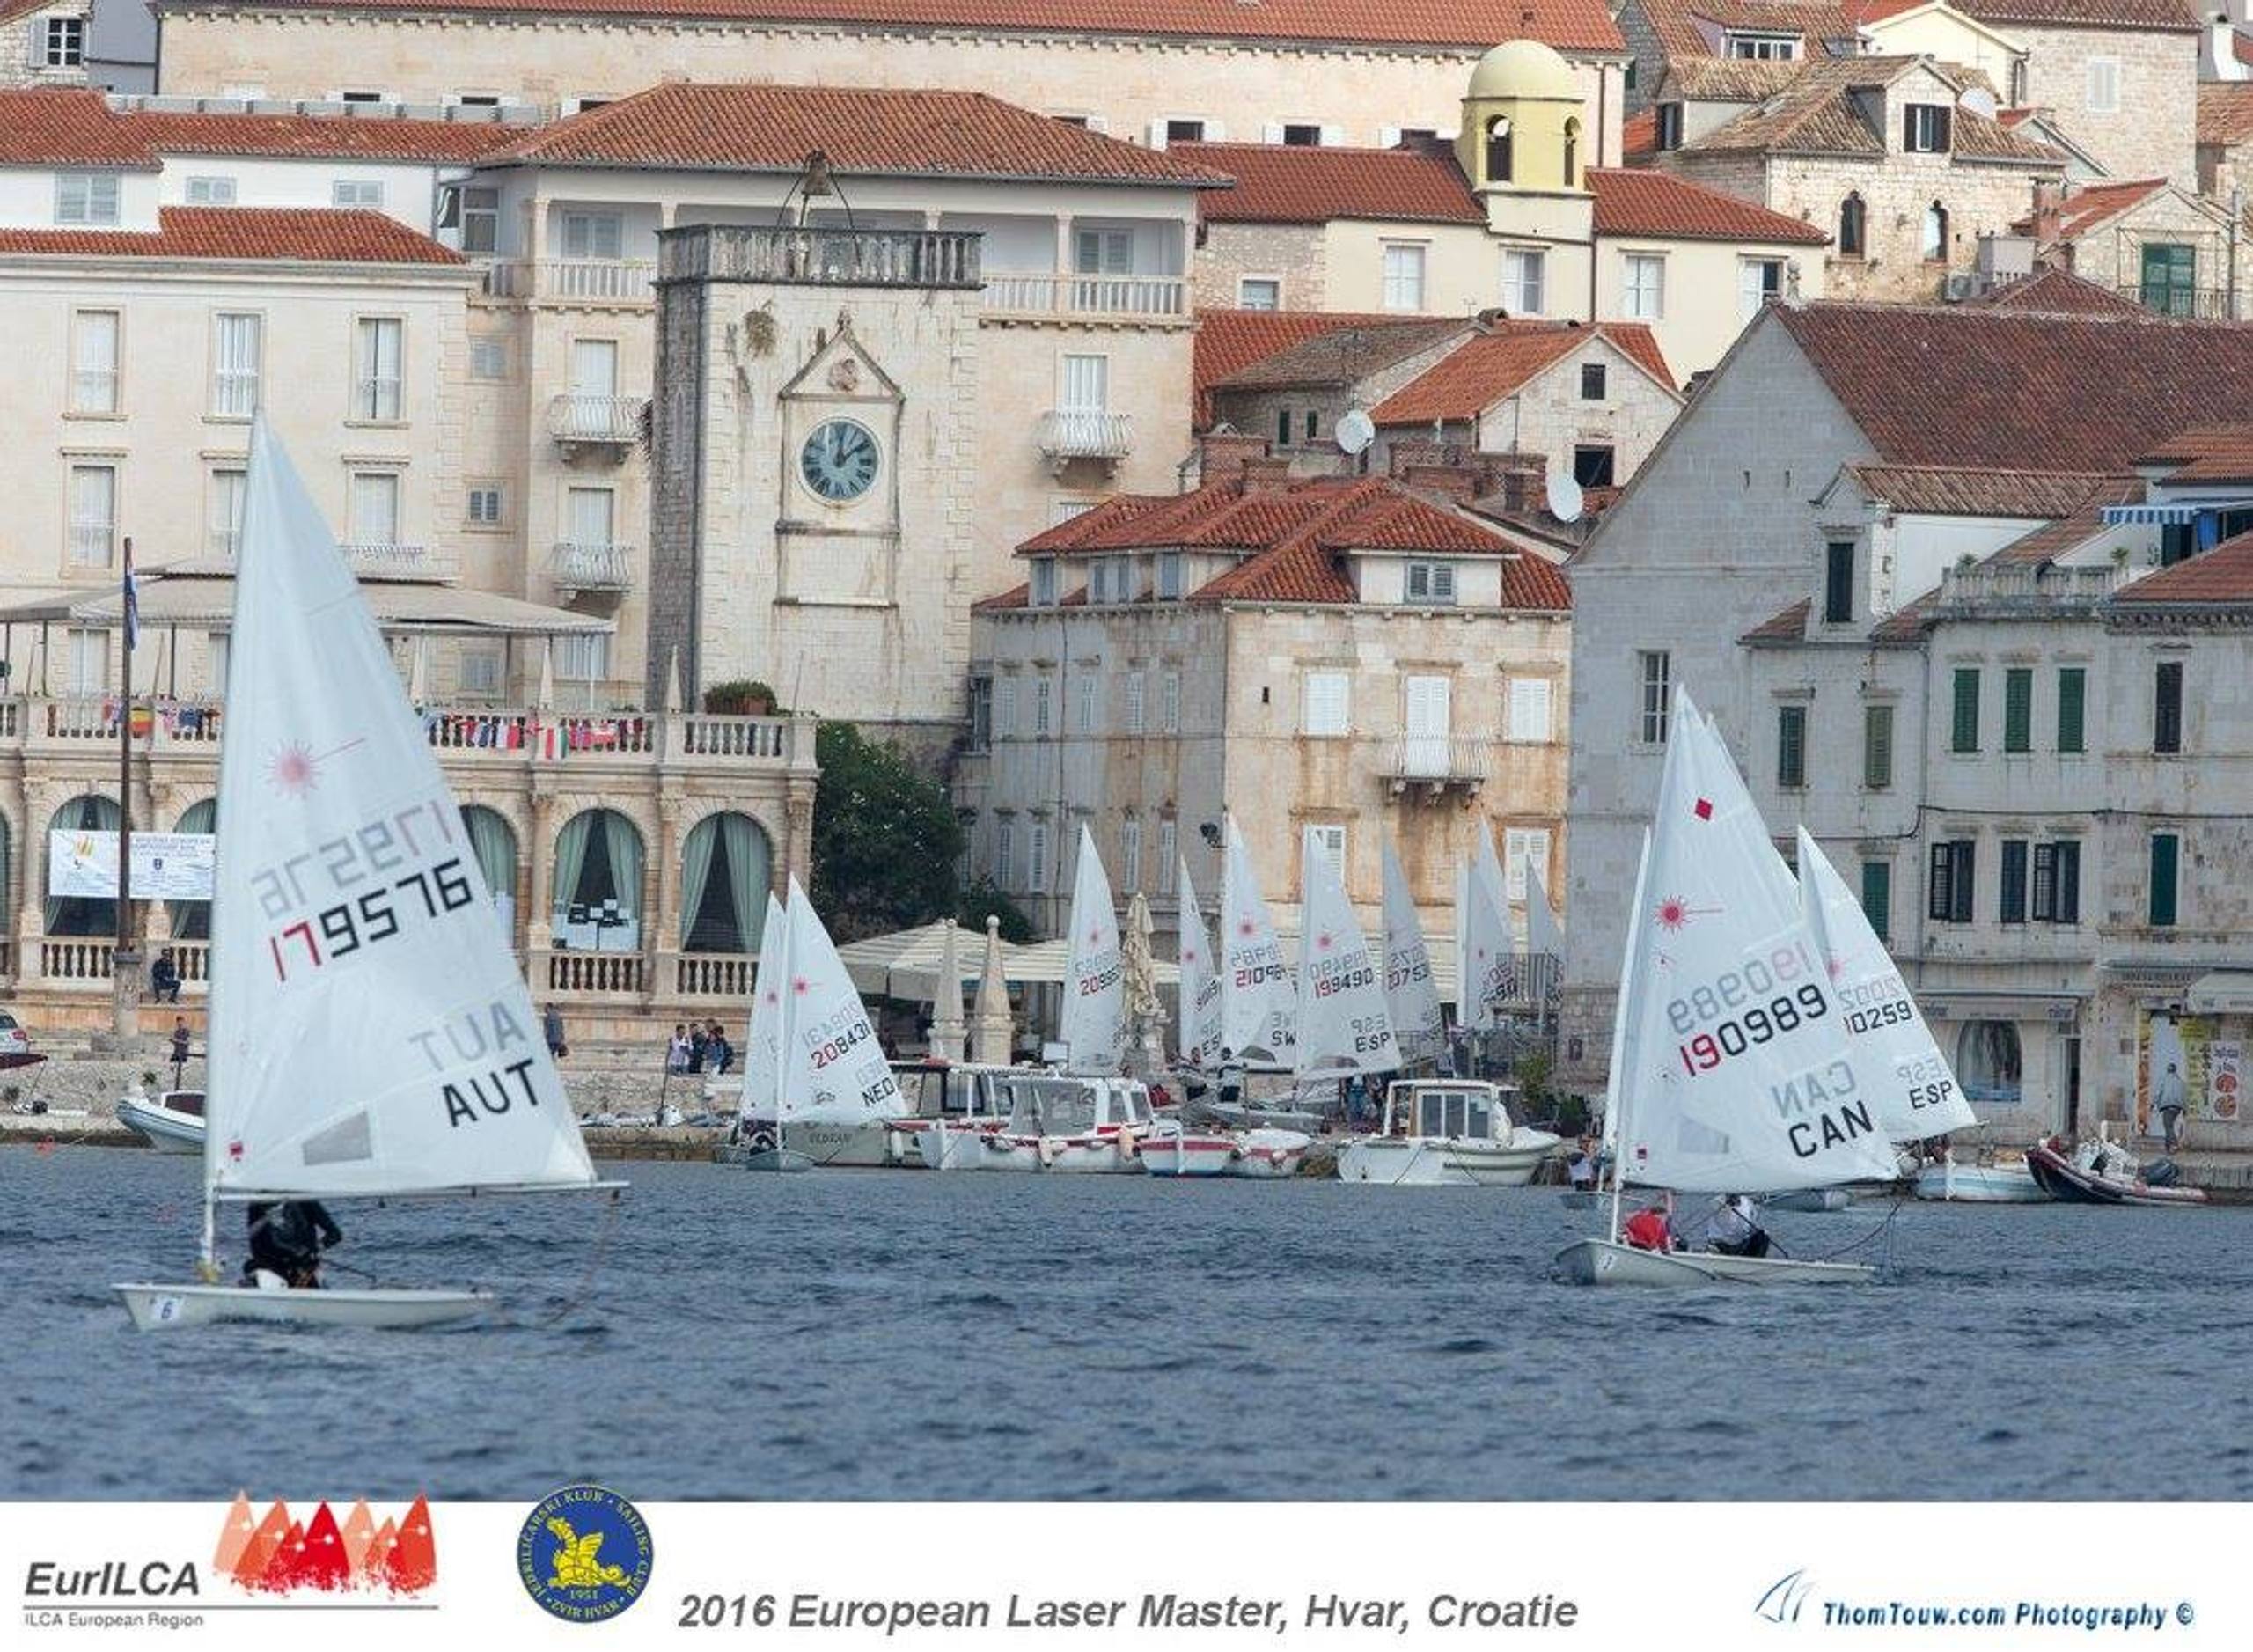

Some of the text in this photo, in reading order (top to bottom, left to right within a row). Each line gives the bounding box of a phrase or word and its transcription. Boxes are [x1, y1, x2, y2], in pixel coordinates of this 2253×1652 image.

[270, 857, 473, 981] 179576
[1315, 967, 1374, 999] 199490
[811, 1019, 871, 1069] 208431
[1355, 1032, 1391, 1053] ESP
[1679, 984, 1827, 1077] 190989
[441, 1057, 539, 1127] AUT
[861, 1077, 896, 1107] NED
[1909, 1079, 1952, 1110] ESP
[1788, 1099, 1874, 1158] CAN
